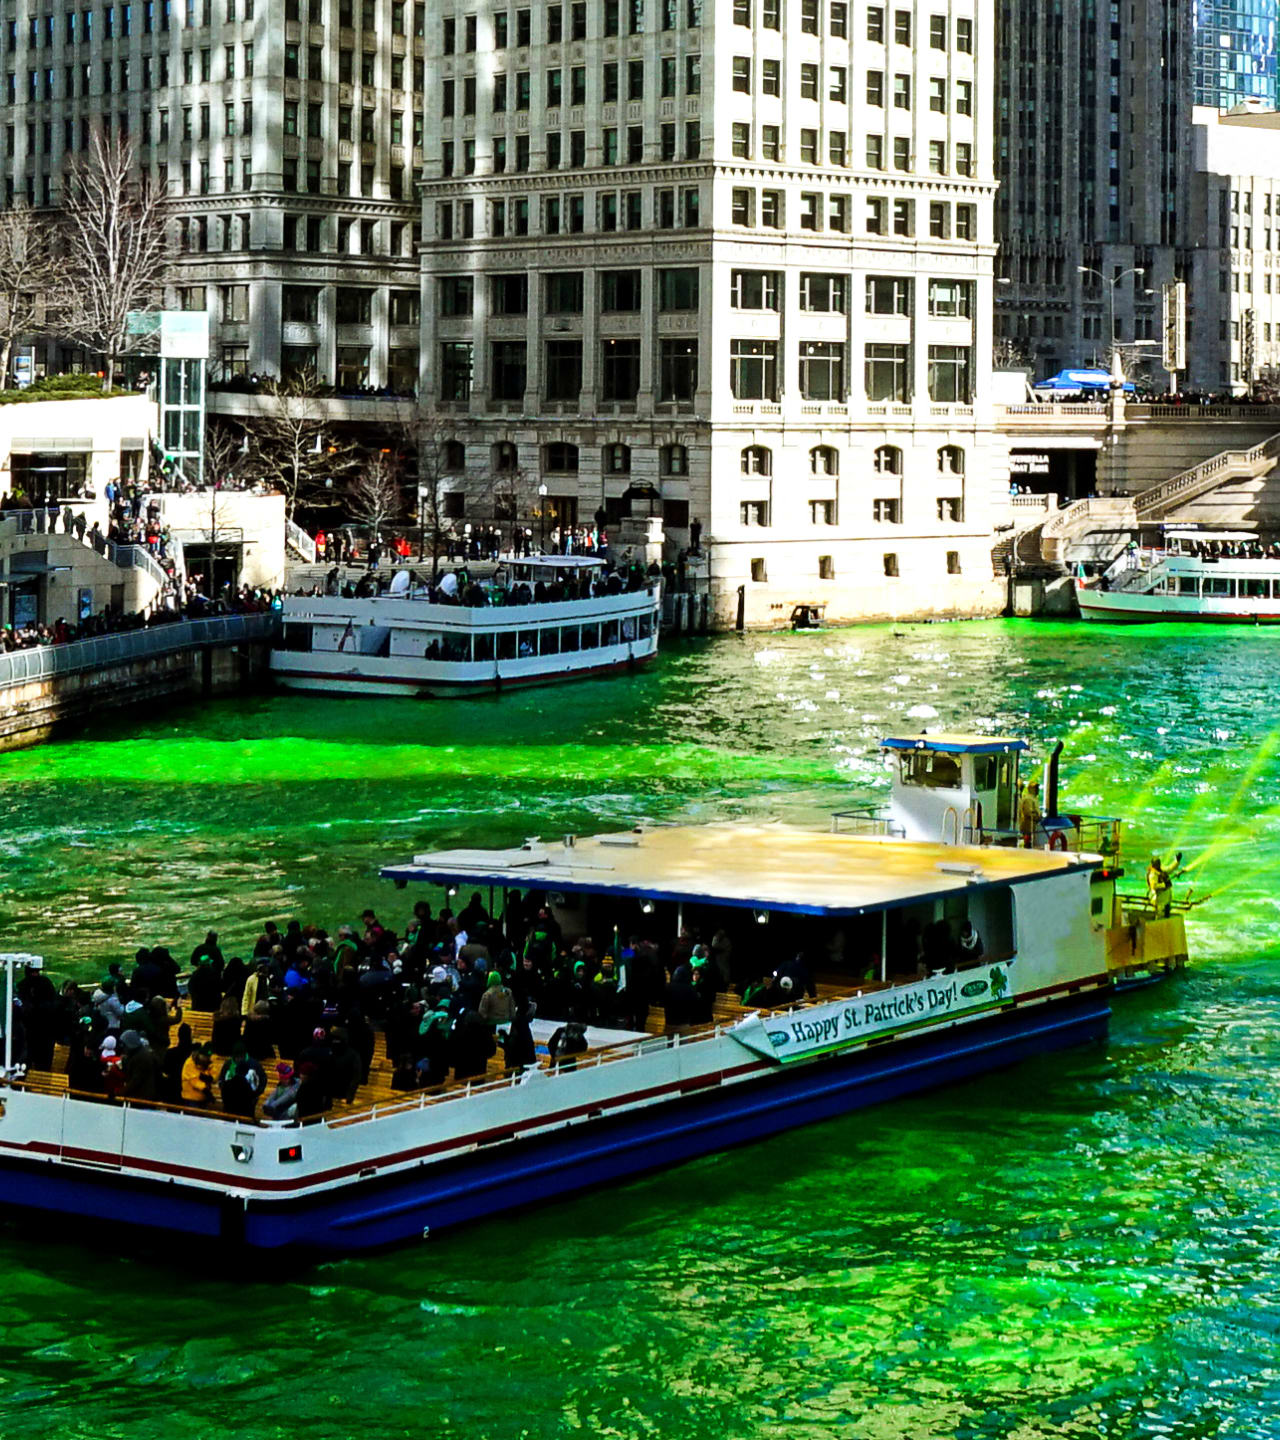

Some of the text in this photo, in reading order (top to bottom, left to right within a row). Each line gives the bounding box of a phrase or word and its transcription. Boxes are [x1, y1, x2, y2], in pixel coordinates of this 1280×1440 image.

[790, 1015, 839, 1043] Happy
[844, 1007, 862, 1029] St.
[864, 992, 924, 1024] Patrick's
[926, 981, 958, 1008] Day!
